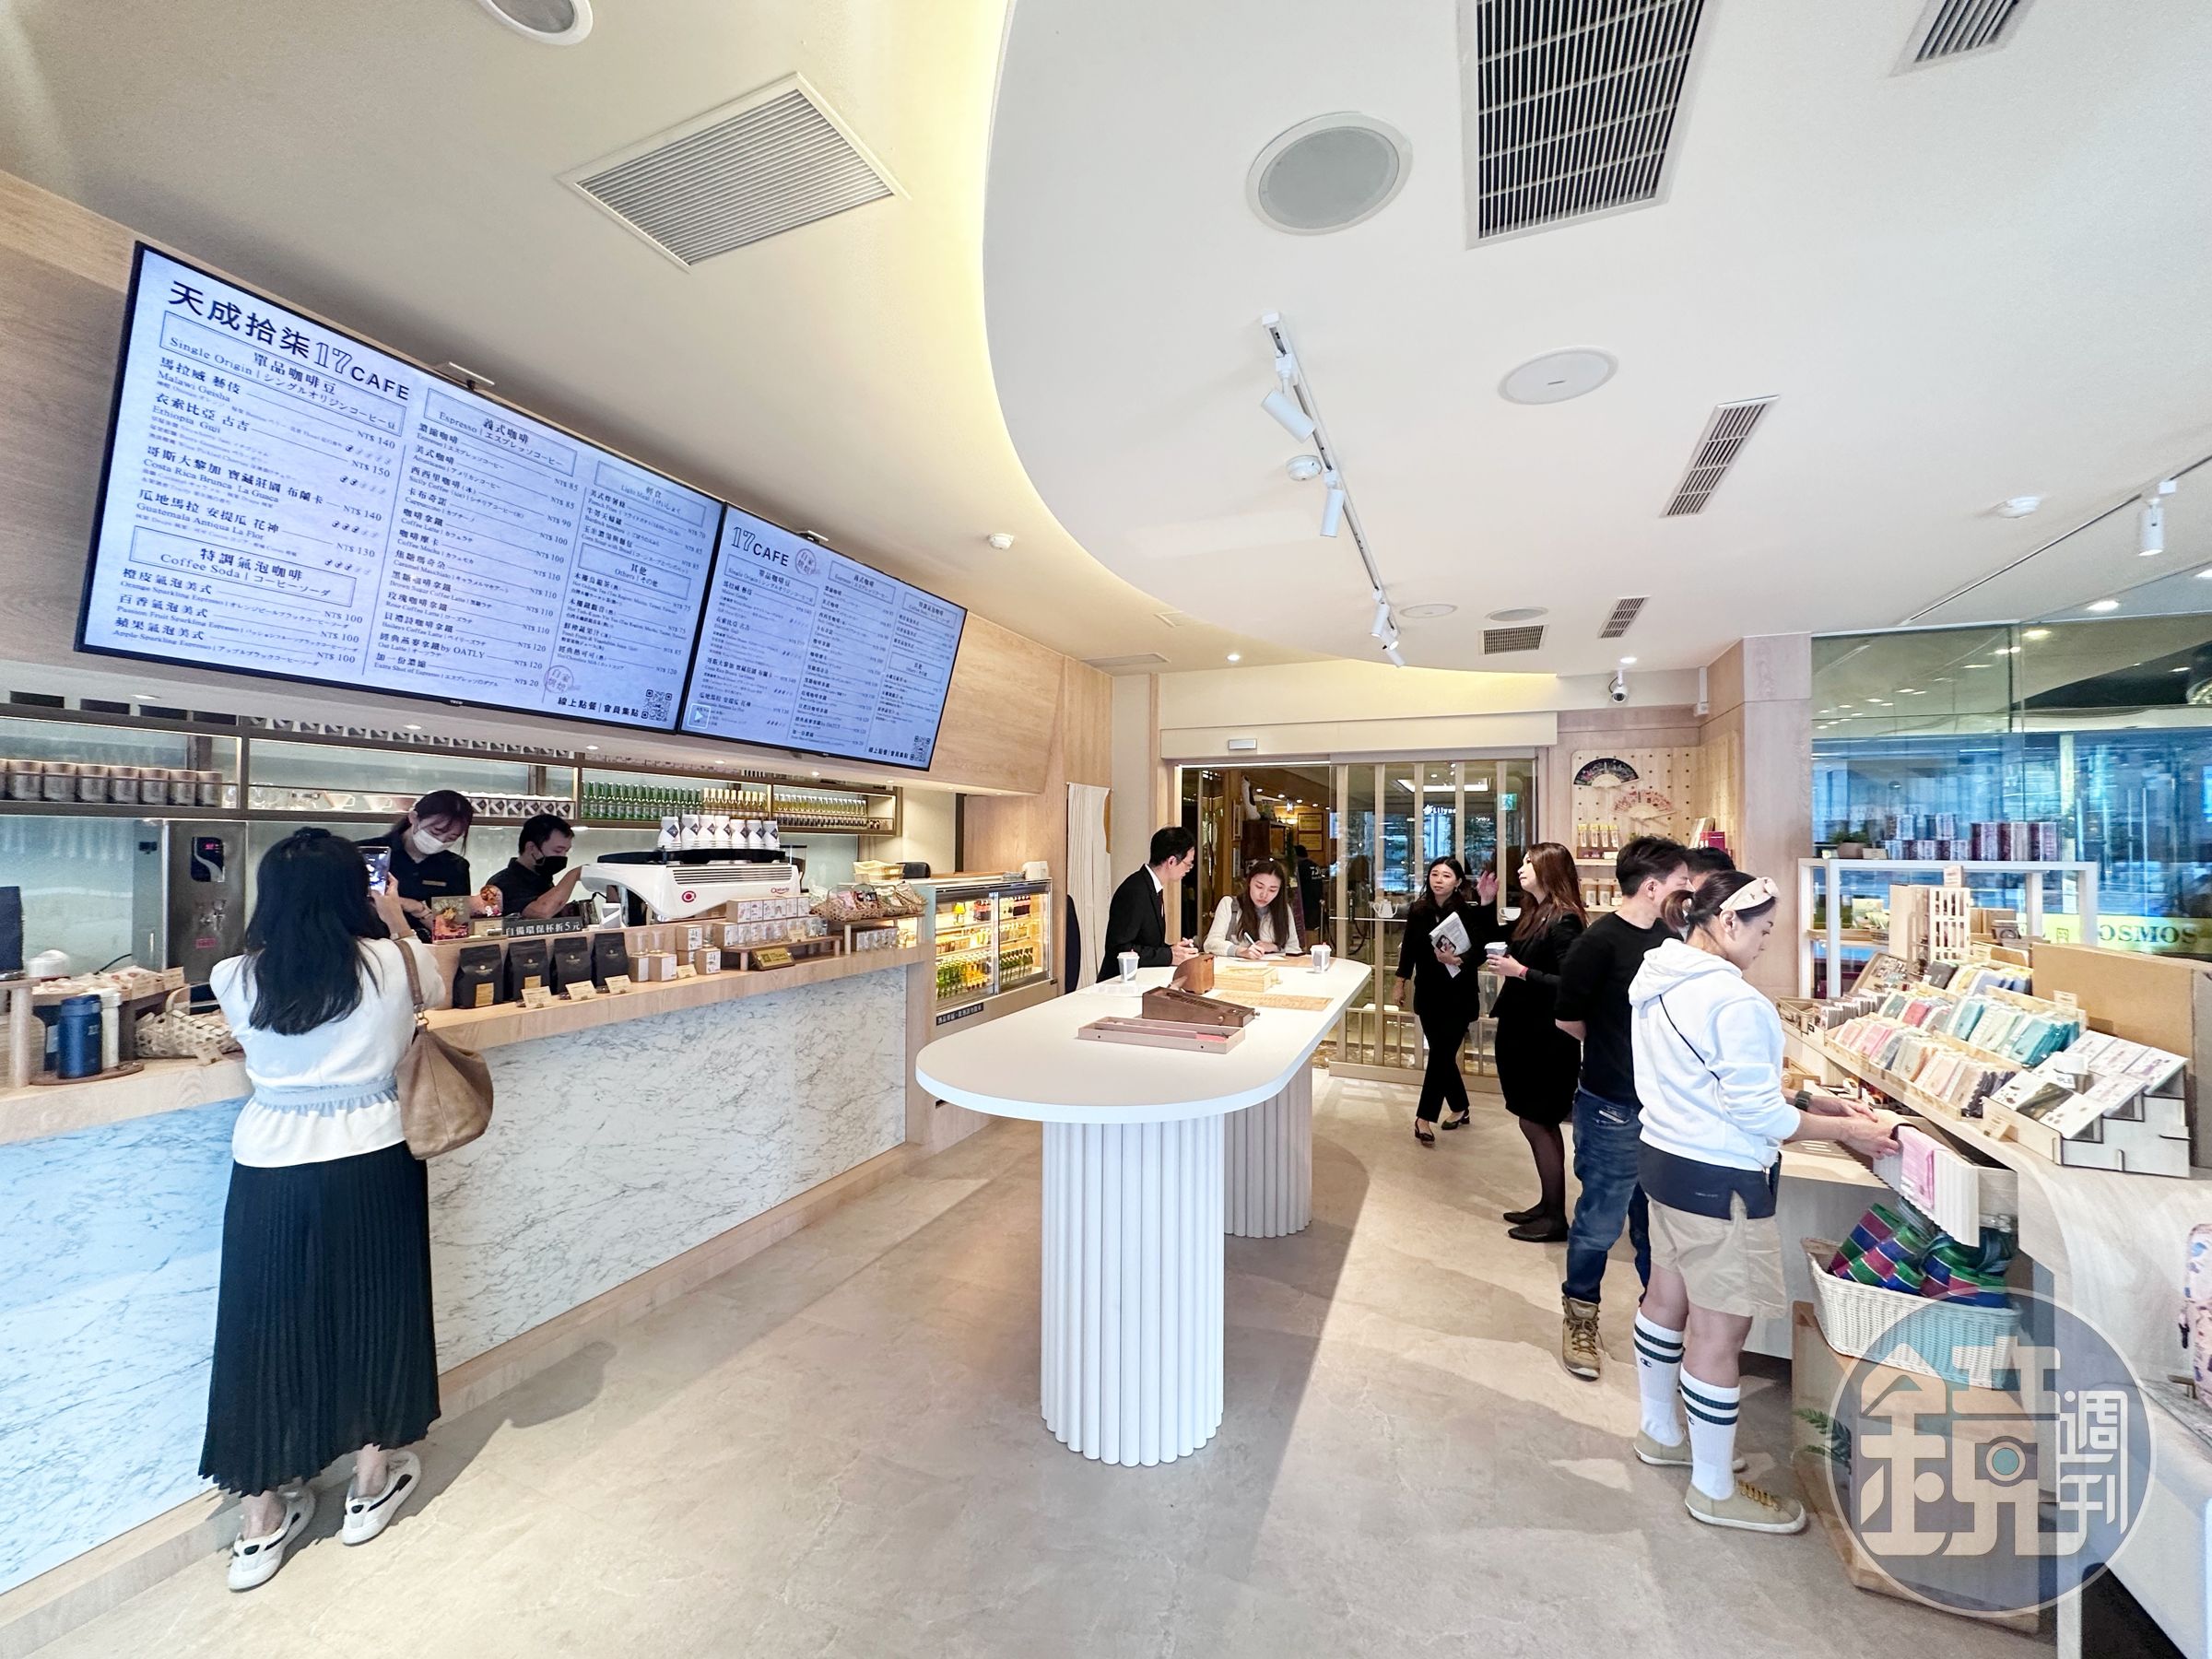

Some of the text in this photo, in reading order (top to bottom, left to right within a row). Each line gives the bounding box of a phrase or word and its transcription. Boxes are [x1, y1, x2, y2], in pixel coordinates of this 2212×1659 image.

[170, 336, 211, 359] Single
[214, 354, 253, 375] Origin
[254, 352, 335, 395] 單品咖啡豆
[158, 370, 230, 403] Malawi Geisha
[160, 357, 395, 450] 馬拉威 藝伎 NT$ 140
[152, 405, 221, 434] Ethiopia Guji
[439, 411, 477, 433] Espresso
[483, 418, 529, 444] 義式咖啡
[156, 393, 391, 478] 衣索比亞 古吉 NT$ 150
[143, 458, 172, 473] Costa
[174, 466, 197, 480] Rica
[199, 474, 233, 490] Brunca
[237, 485, 250, 495] La
[147, 446, 221, 476] 哥斯大黎加
[343, 504, 361, 516] NT$
[364, 510, 382, 522] 140
[416, 444, 575, 510] 美式咖啡 NT$ 85
[554, 477, 568, 488] NT$
[569, 482, 579, 492] 85
[135, 502, 265, 541] Guatemala La Flor
[139, 489, 199, 513] 瓜地馬拉
[206, 507, 247, 526] 安提瓜
[253, 518, 279, 534] 花神
[336, 542, 355, 553] NT$
[358, 547, 376, 558] 130
[400, 517, 440, 534] Coffee Latte
[409, 487, 569, 546] 卡布奇諾 NT$ 100
[547, 514, 571, 528] NT$ 90
[396, 538, 419, 549] Coffee
[403, 508, 565, 564] 咖啡拿鐵 NT$ 100
[200, 548, 302, 581] 特調氣泡咖啡
[399, 529, 561, 582] 咖啡摩卡 NT$ 110
[159, 554, 331, 597] Coffee Soda コーヒーソーダ
[614, 568, 635, 581] Others
[630, 563, 647, 576] 其他
[120, 581, 151, 592] Orange
[152, 586, 190, 600] Sparkling
[123, 568, 363, 624] 橙皮氣泡美式 NT$ 100
[529, 587, 543, 596] NT$
[544, 590, 558, 600] 110
[120, 594, 359, 643] 百香氣泡美式 NT$ 100
[149, 611, 170, 620] Fruit
[170, 615, 206, 627] Sparkling
[525, 606, 554, 618] NT$ 110
[112, 629, 139, 639] Apple
[139, 633, 178, 645] Sparkling
[115, 617, 356, 664] 蘋果氣泡美式 NT$ 100
[522, 623, 535, 632] NT$
[536, 626, 550, 635] 110
[453, 646, 543, 670] OATLY NT$ 120
[517, 641, 532, 650] NT$
[533, 642, 547, 653] 120
[514, 677, 528, 686] NT$
[528, 679, 539, 688] 20
[558, 697, 639, 717] 線上點餐 會員集點
[868, 747, 888, 756] 線上點餐
[505, 922, 581, 935] 自備環保杯折5元
[2099, 924, 2199, 945] OSMOS
